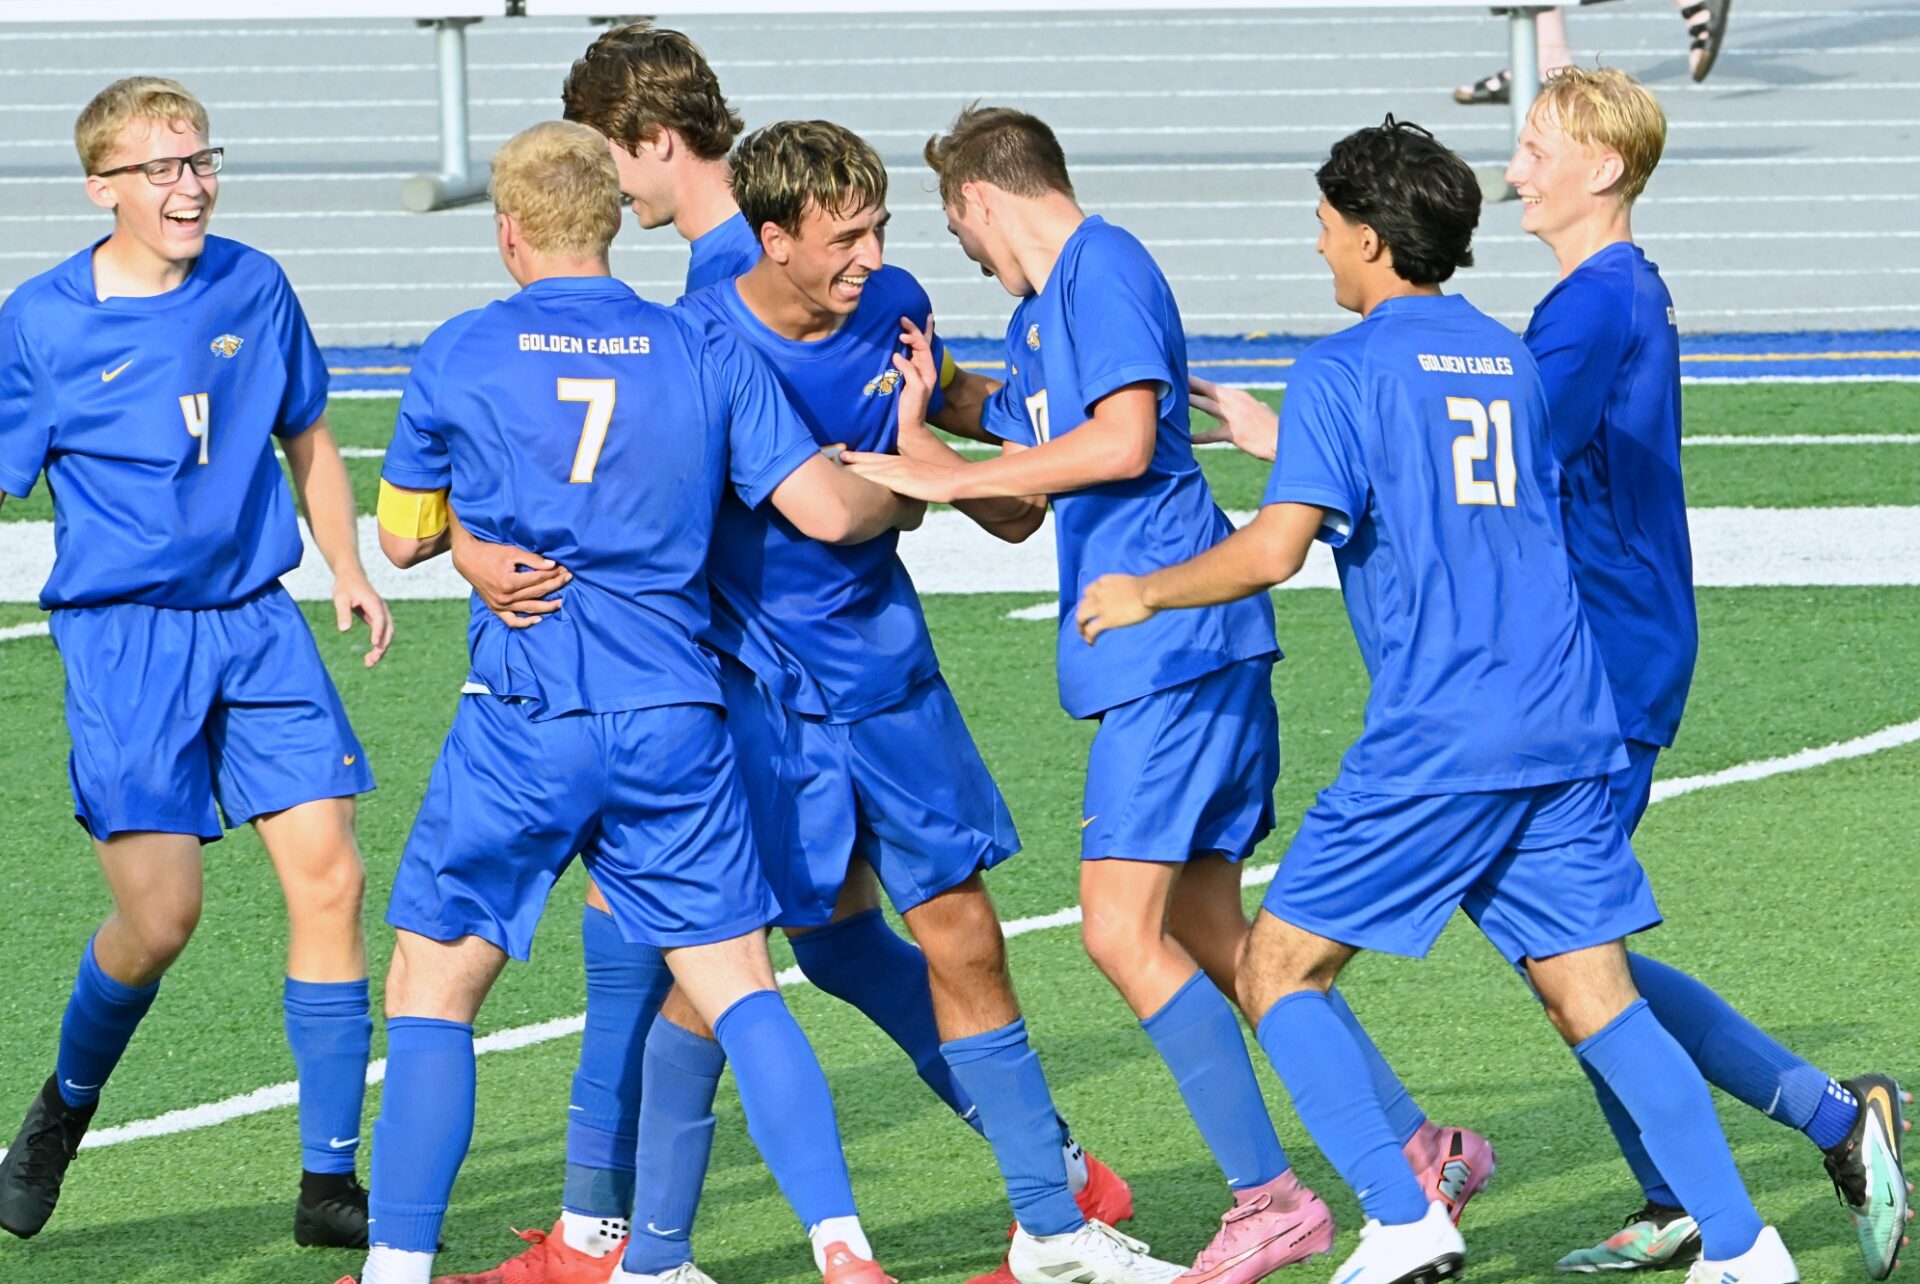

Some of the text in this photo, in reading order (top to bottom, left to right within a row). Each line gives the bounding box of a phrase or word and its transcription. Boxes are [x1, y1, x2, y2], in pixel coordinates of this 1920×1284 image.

[519, 333, 650, 354] GOLDEN EAGLES
[1417, 354, 1514, 375] GOLDEN EAGLES
[178, 392, 209, 464] 4
[557, 377, 616, 483] 7
[1445, 396, 1517, 506] 21
